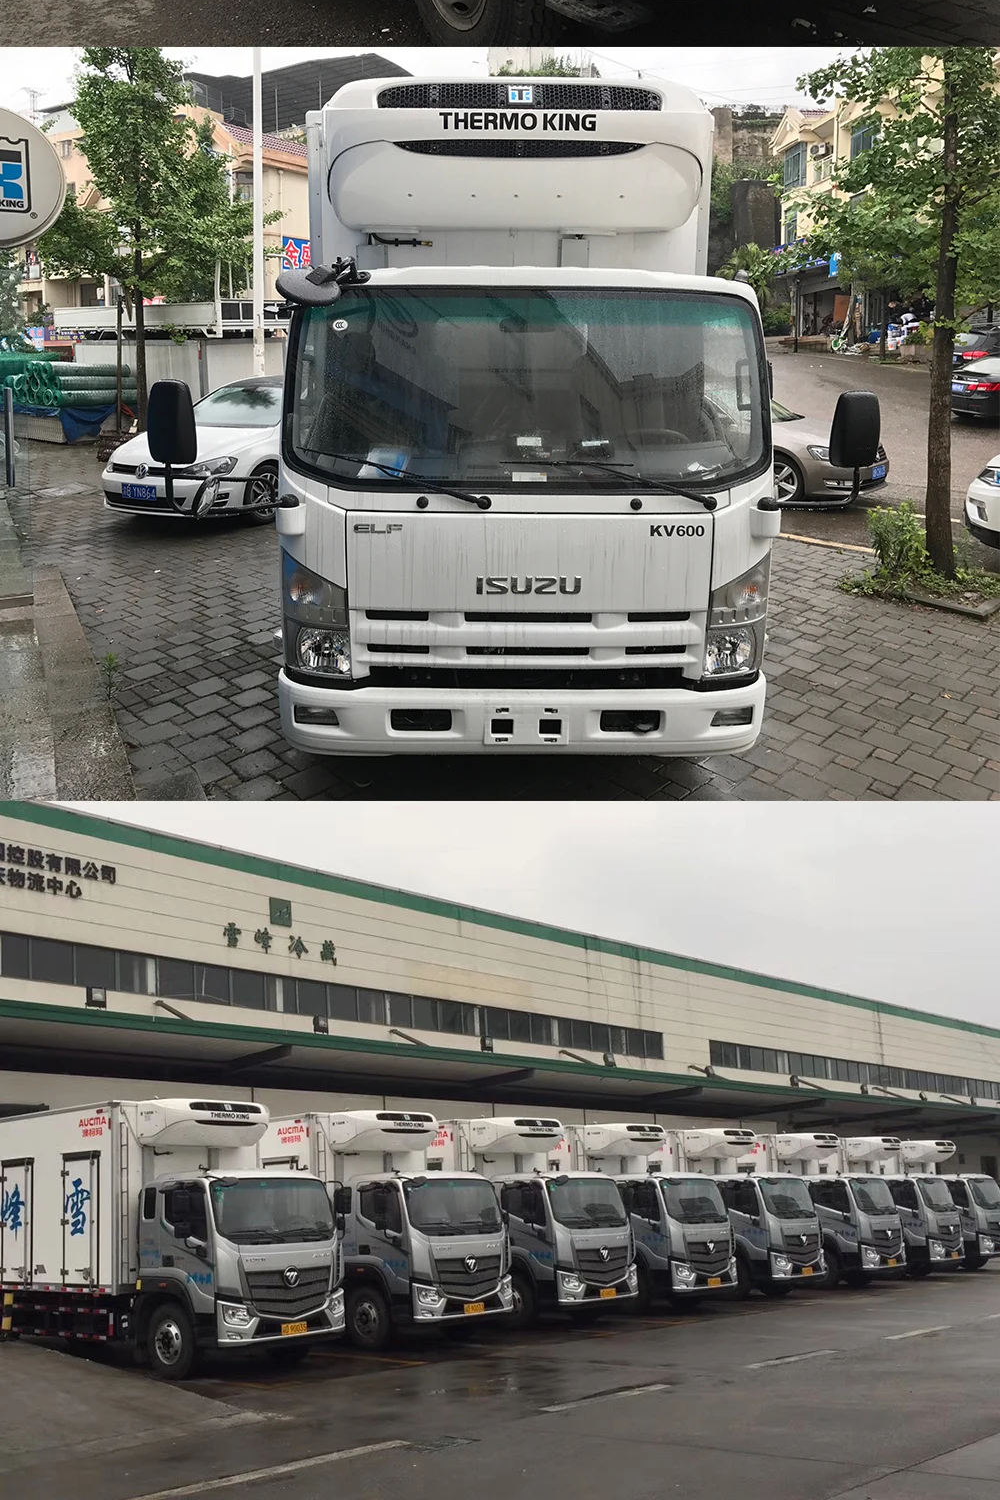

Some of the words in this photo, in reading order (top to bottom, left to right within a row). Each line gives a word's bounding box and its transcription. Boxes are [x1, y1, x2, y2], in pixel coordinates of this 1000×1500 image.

[439, 112, 537, 130] THERMO
[542, 113, 597, 131] KING
[353, 523, 403, 534] ELF
[650, 525, 705, 537] KV600
[476, 576, 582, 595] ISUZU
[78, 1116, 107, 1128] AUCMA
[210, 1112, 235, 1120] THERMO
[277, 1126, 304, 1136] AUCMA
